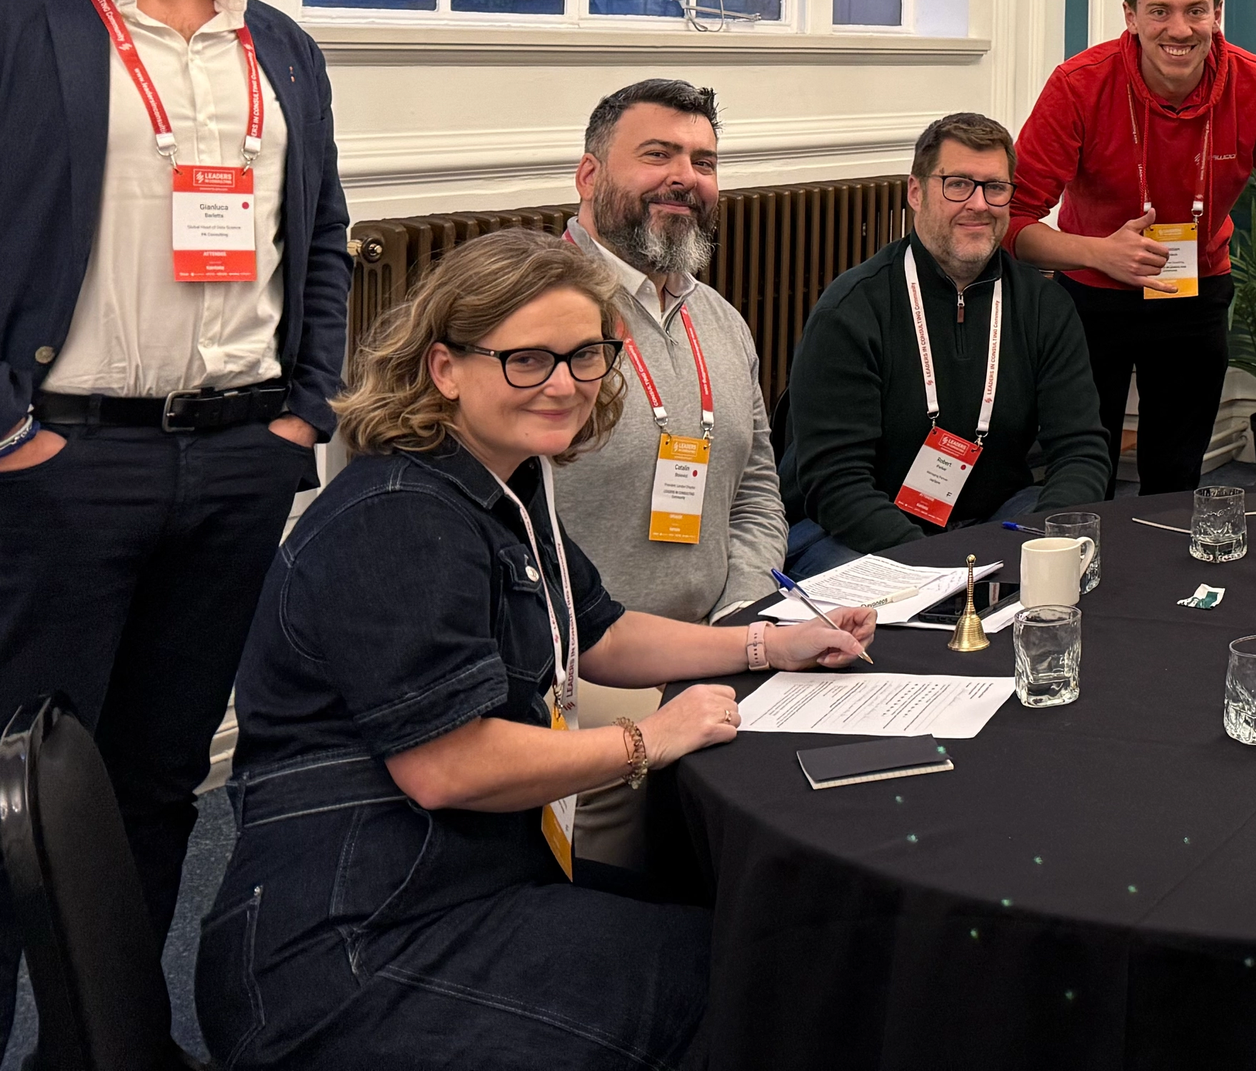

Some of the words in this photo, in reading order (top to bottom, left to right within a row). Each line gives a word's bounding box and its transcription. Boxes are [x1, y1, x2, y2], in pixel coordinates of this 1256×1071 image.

[106, 11, 125, 41] Community
[204, 172, 232, 180] LEADERS
[911, 282, 920, 311] Community
[917, 310, 926, 346] CONSULTING
[921, 345, 927, 353] IN
[922, 351, 932, 378] LEADERS
[989, 363, 995, 371] IN
[987, 371, 995, 395] LEADERS
[678, 442, 697, 450] LEADERS
[948, 438, 967, 449] LEADERS
[937, 456, 952, 468] Robert
[570, 647, 576, 657] IN
[566, 658, 575, 698] LEADERS
